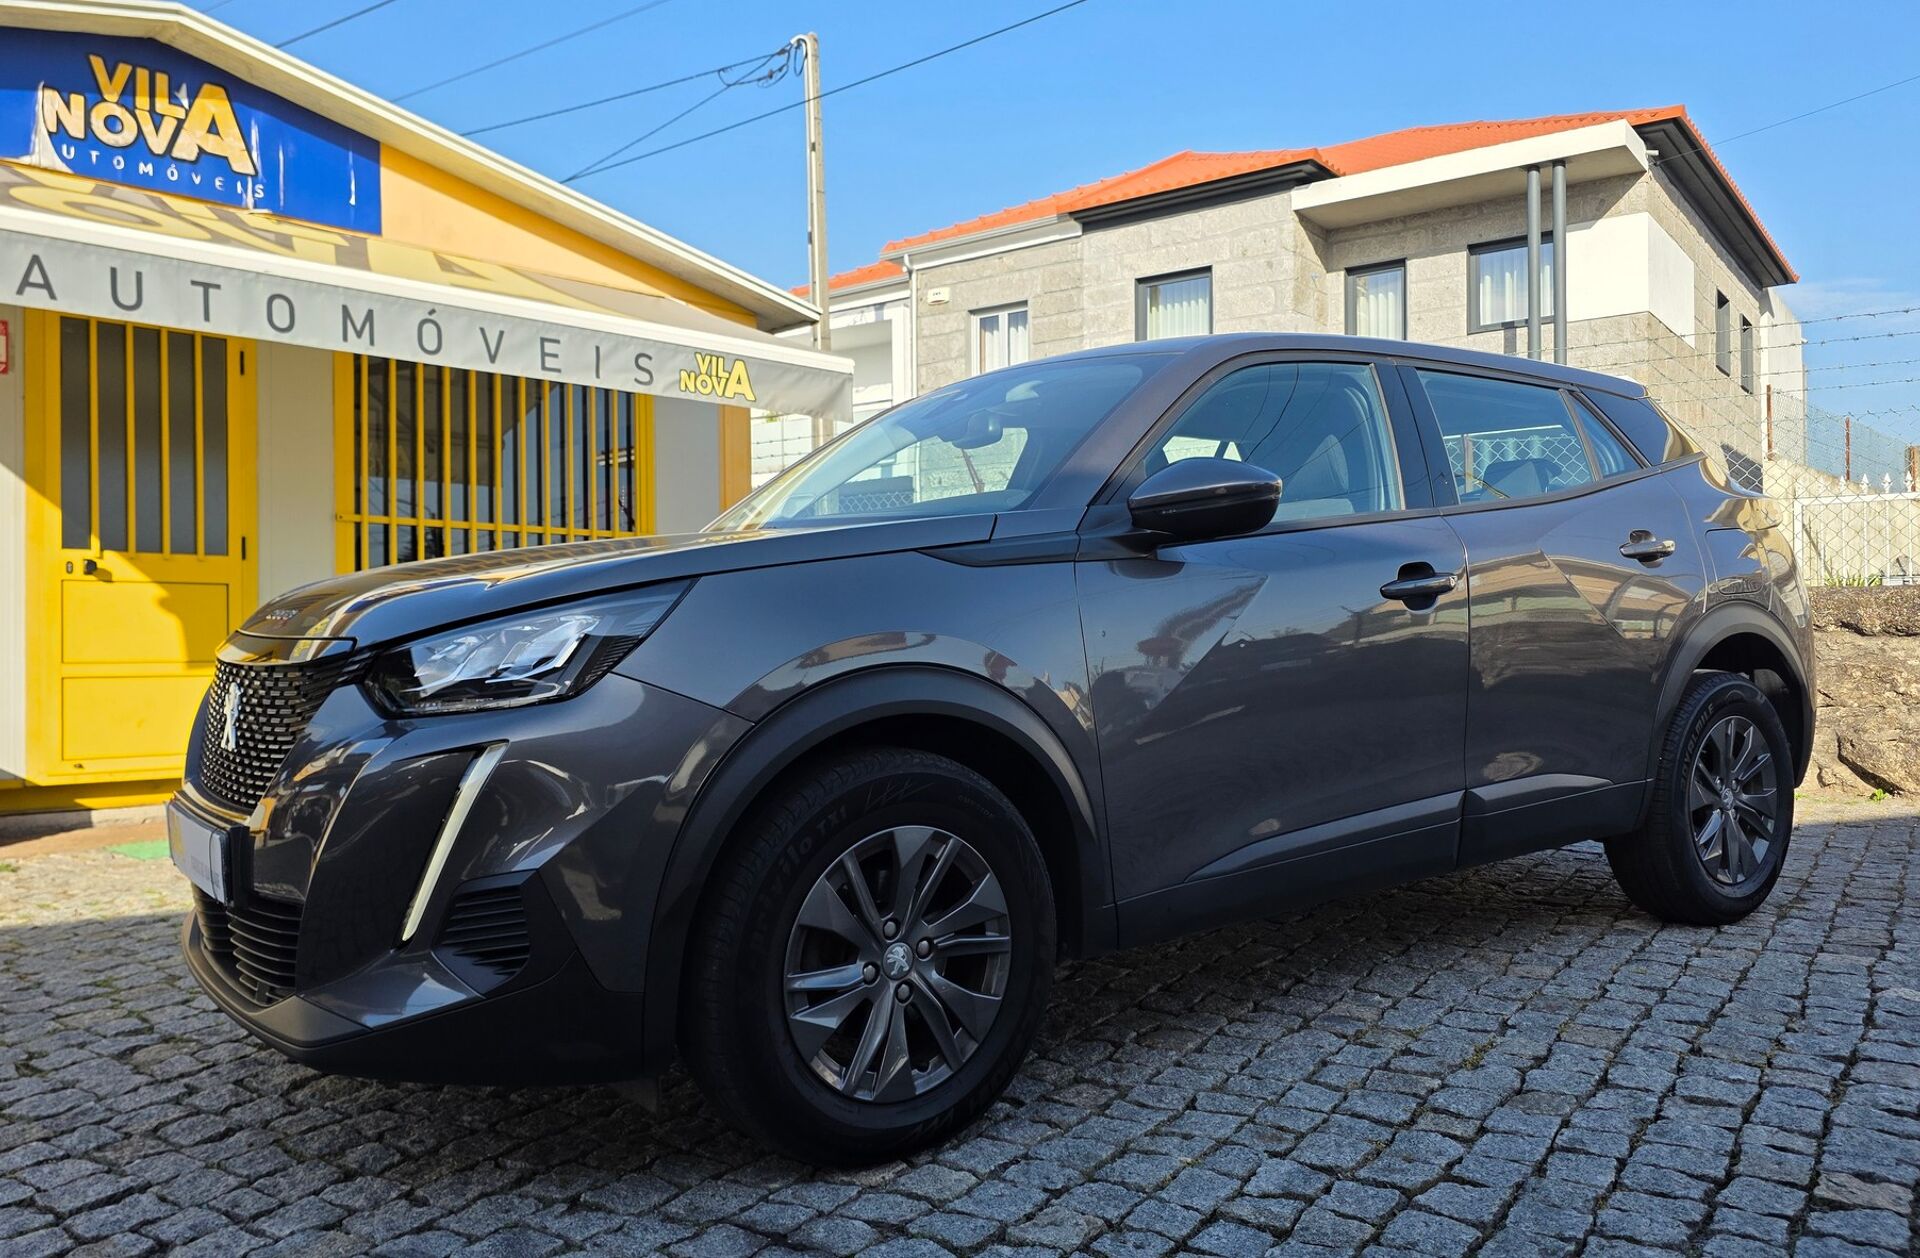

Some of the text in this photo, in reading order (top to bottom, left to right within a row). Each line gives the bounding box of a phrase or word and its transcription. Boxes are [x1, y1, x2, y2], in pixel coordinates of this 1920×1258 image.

[41, 83, 258, 176] NOVA
[88, 53, 258, 176] VILA
[61, 143, 265, 199] UTOMÓVEIS
[15, 253, 655, 387] AUTOMÓVEIS
[679, 359, 757, 401] NOVA
[694, 352, 757, 401] VILA
